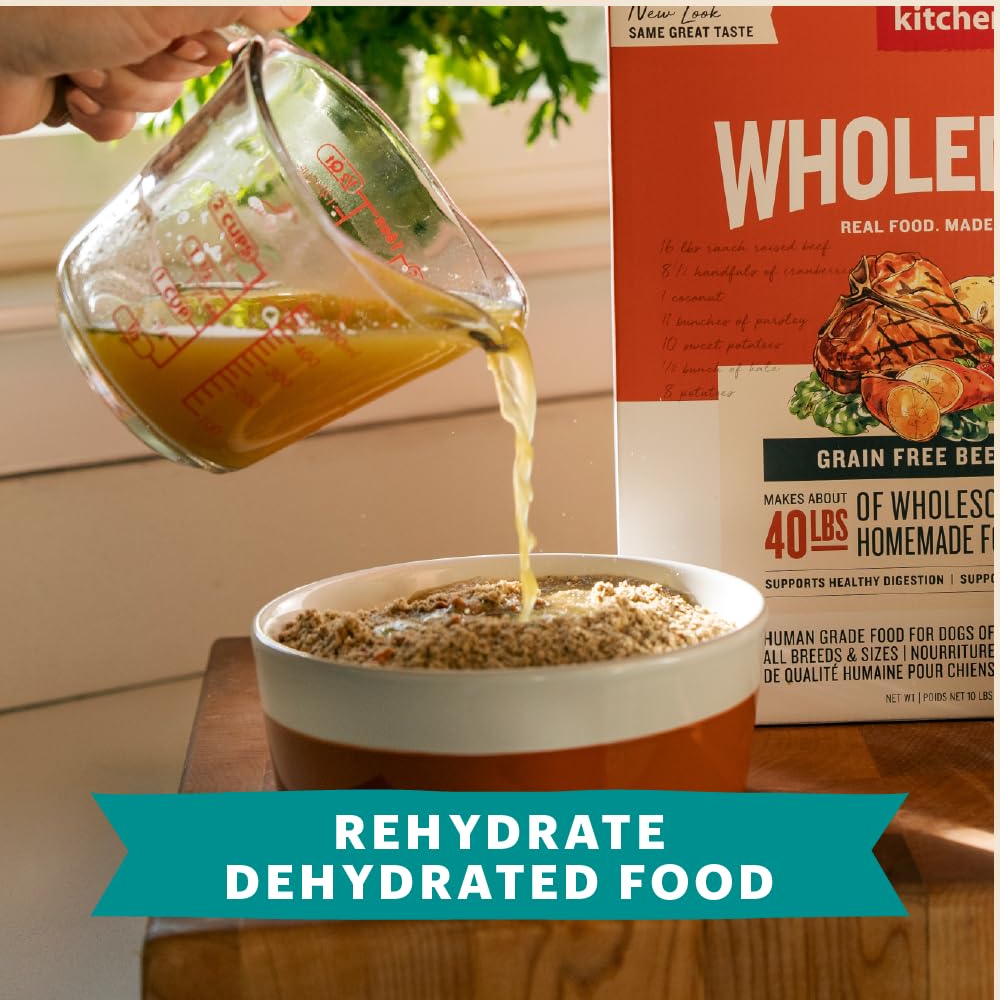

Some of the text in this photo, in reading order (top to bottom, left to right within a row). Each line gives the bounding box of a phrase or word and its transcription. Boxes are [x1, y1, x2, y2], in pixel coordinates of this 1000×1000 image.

[627, 6, 722, 23] New Look
[893, 6, 994, 31] kitche
[629, 25, 755, 39] SAME GREAT TASTE
[222, 213, 252, 259] CUPS
[840, 218, 993, 234] REAL FOOD. MADE
[801, 239, 832, 256] beef
[763, 264, 777, 282] of
[164, 287, 191, 317] CUP
[735, 314, 749, 331] of
[817, 448, 885, 469] GRAIN
[893, 446, 947, 467] FREE
[764, 492, 848, 505] MAKES ABOUT
[856, 491, 884, 522] OF
[765, 508, 849, 559] 40 LBS
[857, 524, 974, 557] HOMEMADE
[765, 577, 826, 590] SUPPORTS
[829, 576, 880, 588] HEALTHY
[883, 574, 944, 587] DIGESTION
[764, 625, 994, 647] HUMAN GRADE FOOD FOR DOGS OF
[763, 644, 994, 665] ALL BREEDS & SIZES NOURRITURE
[764, 662, 994, 685] DE QUALITÉ HUMAINE POUR CHIENS
[885, 693, 901, 703] NET
[923, 692, 947, 702] POIDS
[949, 691, 965, 702] NET
[967, 691, 977, 701] 10
[978, 690, 994, 701] LBS
